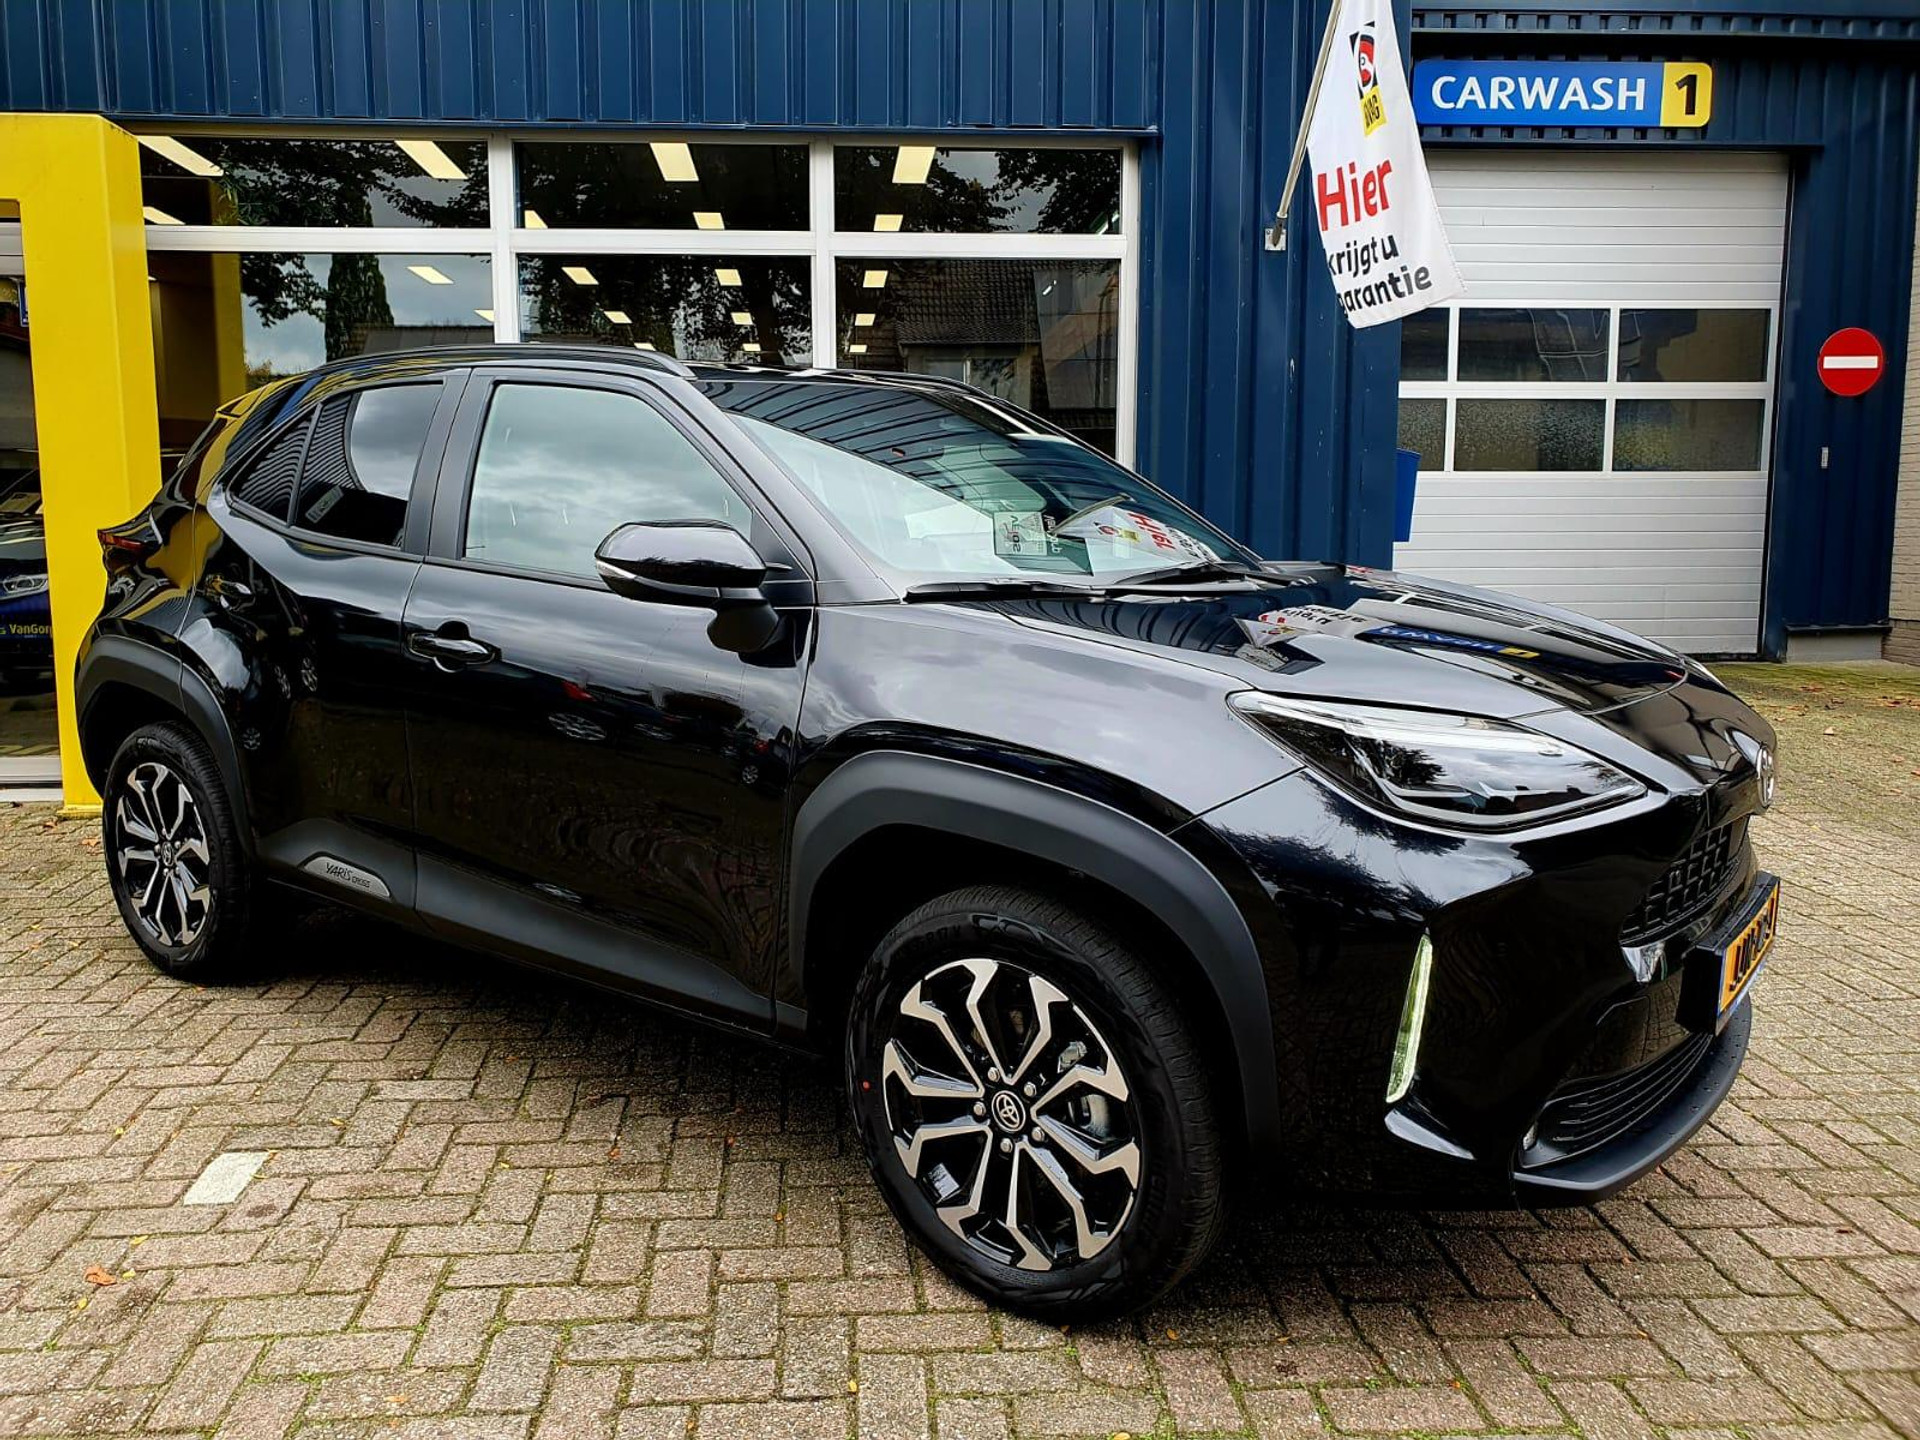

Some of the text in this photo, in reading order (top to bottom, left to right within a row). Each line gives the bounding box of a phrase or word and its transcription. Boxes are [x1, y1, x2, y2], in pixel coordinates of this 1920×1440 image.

[1431, 74, 1698, 116] CARWASH 1
[1317, 159, 1392, 231] Hier
[1381, 234, 1399, 261] u
[9, 624, 53, 638] VanGor
